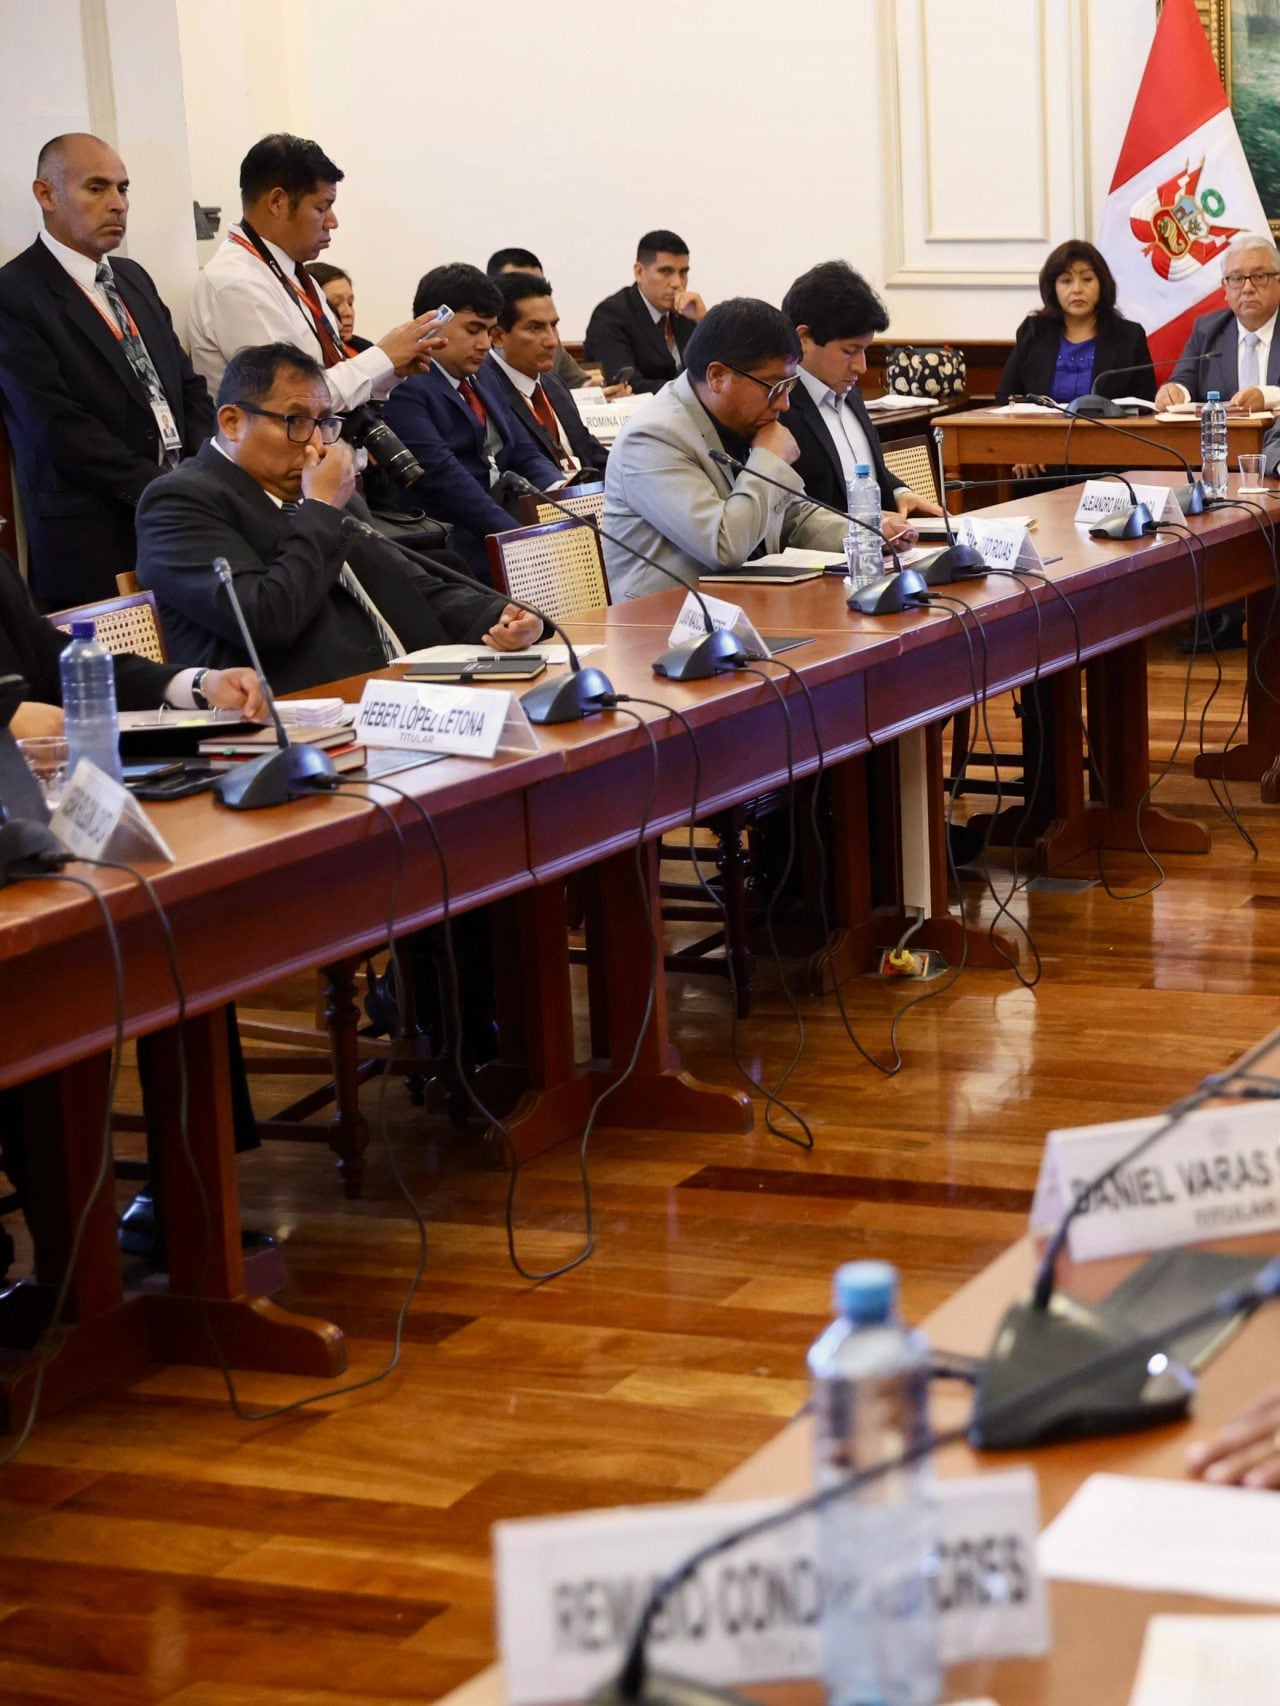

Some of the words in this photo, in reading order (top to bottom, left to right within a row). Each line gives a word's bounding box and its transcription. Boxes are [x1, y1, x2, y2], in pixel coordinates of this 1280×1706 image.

[585, 416, 619, 428] ROMINA
[360, 700, 400, 728] HEBER
[437, 710, 487, 737] LETONA
[399, 731, 435, 745] TITULAR
[1175, 1149, 1272, 1198] VARAS
